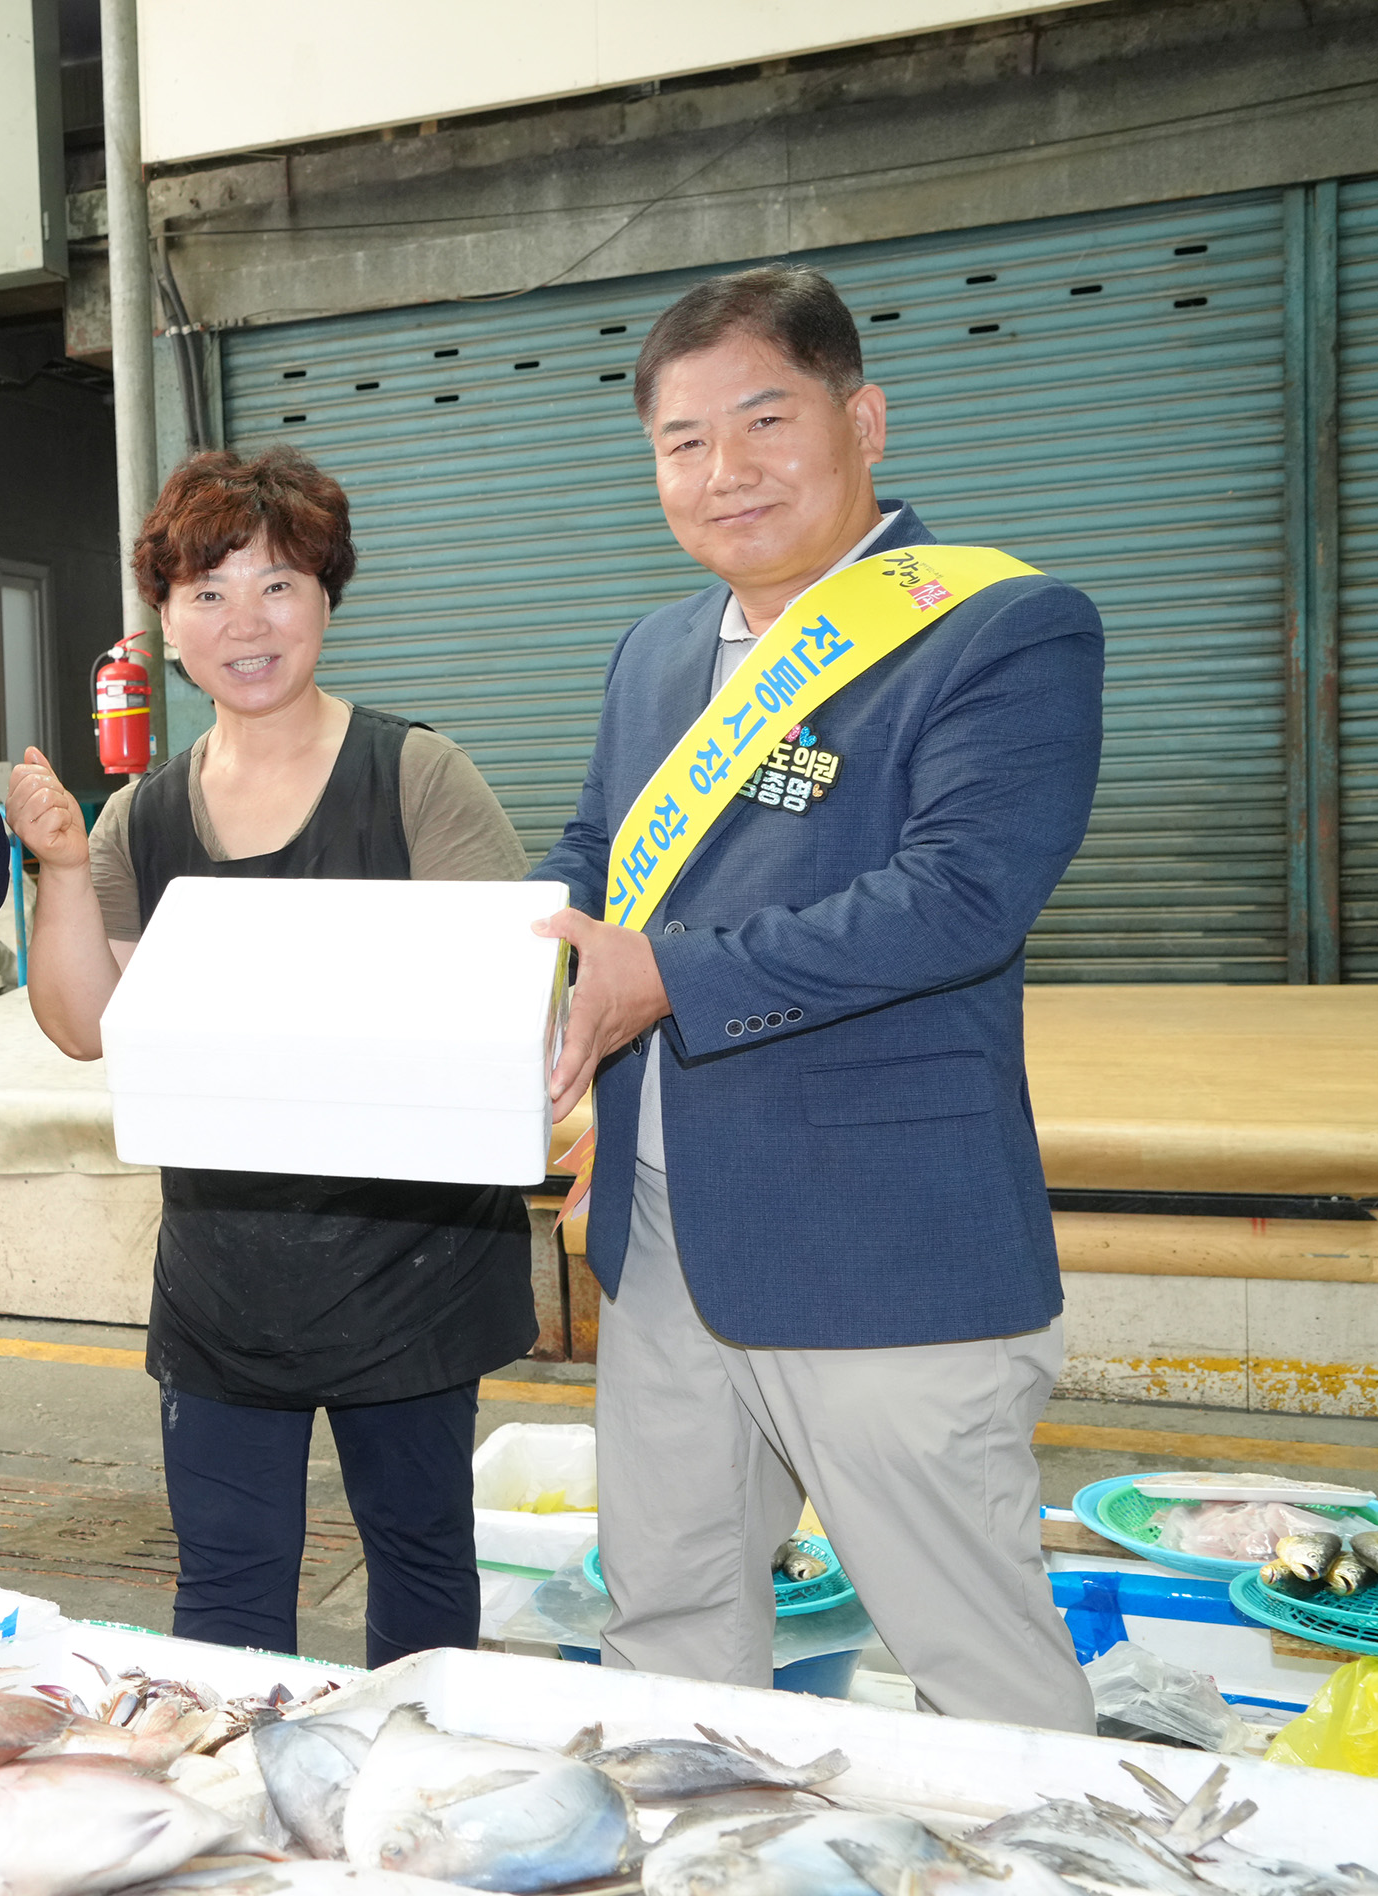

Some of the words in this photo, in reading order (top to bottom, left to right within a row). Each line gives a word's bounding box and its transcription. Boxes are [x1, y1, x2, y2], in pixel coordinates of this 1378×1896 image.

[690, 615, 854, 795] 전통시장
[762, 743, 838, 784] 도의원
[609, 793, 689, 926] 장보기
